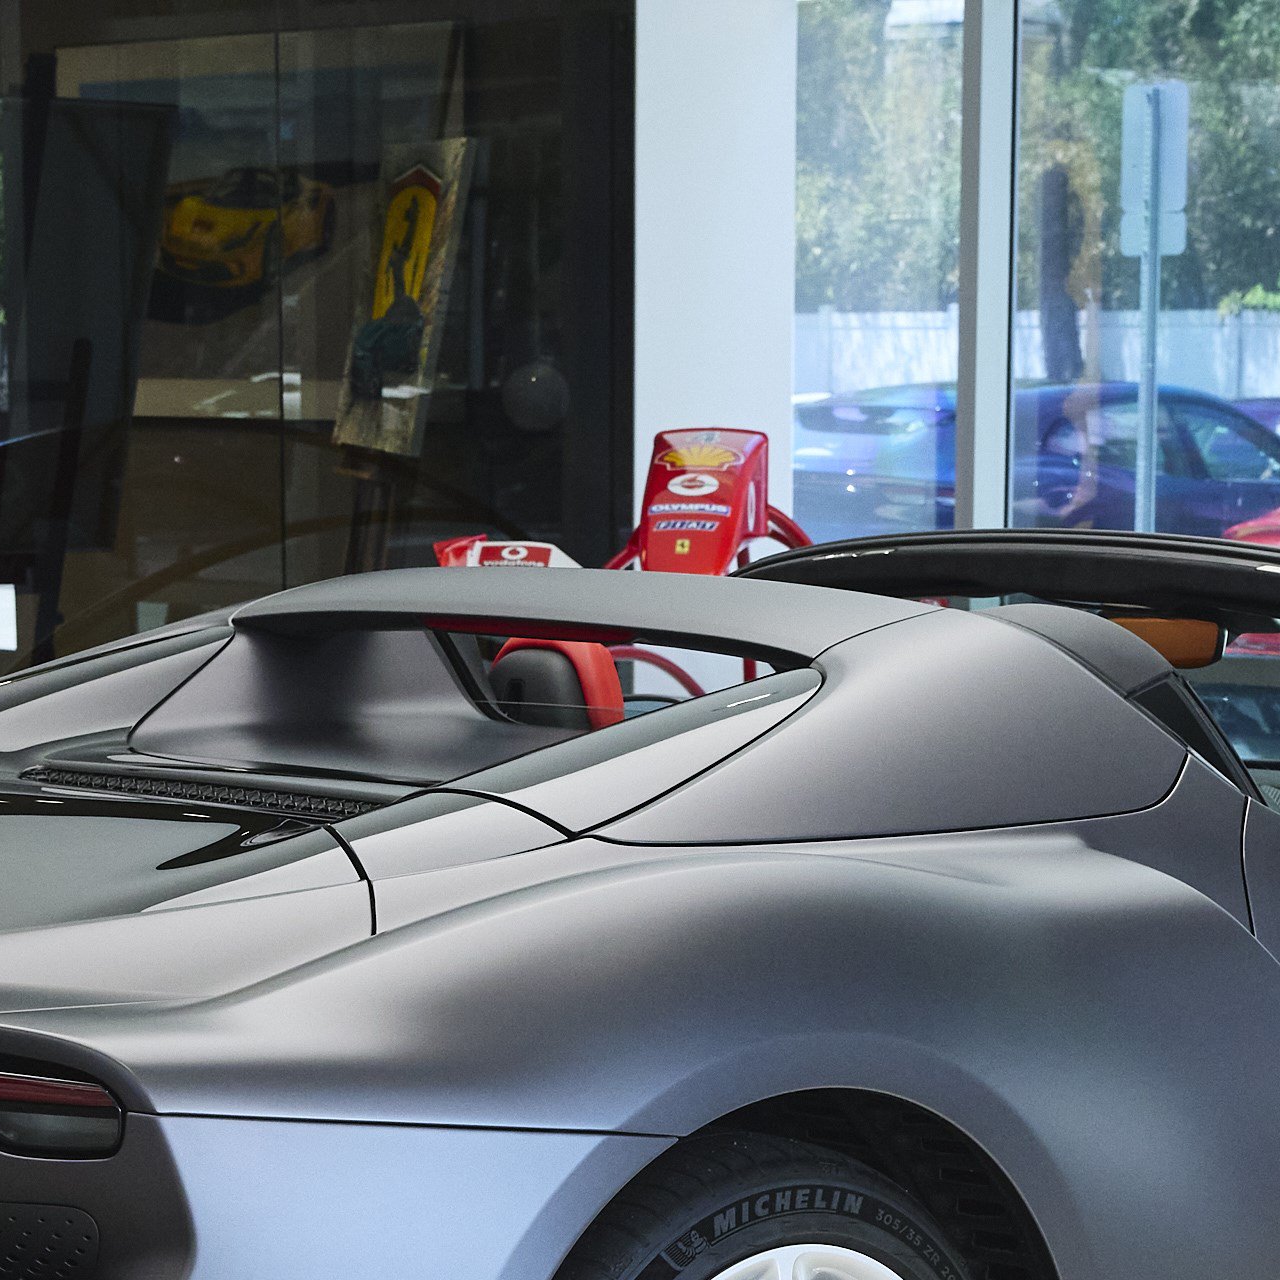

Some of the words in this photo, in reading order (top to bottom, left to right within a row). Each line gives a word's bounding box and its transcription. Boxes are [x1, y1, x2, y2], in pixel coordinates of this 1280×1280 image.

[650, 503, 728, 515] OLYMPUS
[713, 1189, 864, 1238] MICHELIN
[876, 1208, 922, 1246] 305/35
[923, 1244, 940, 1266] ZR
